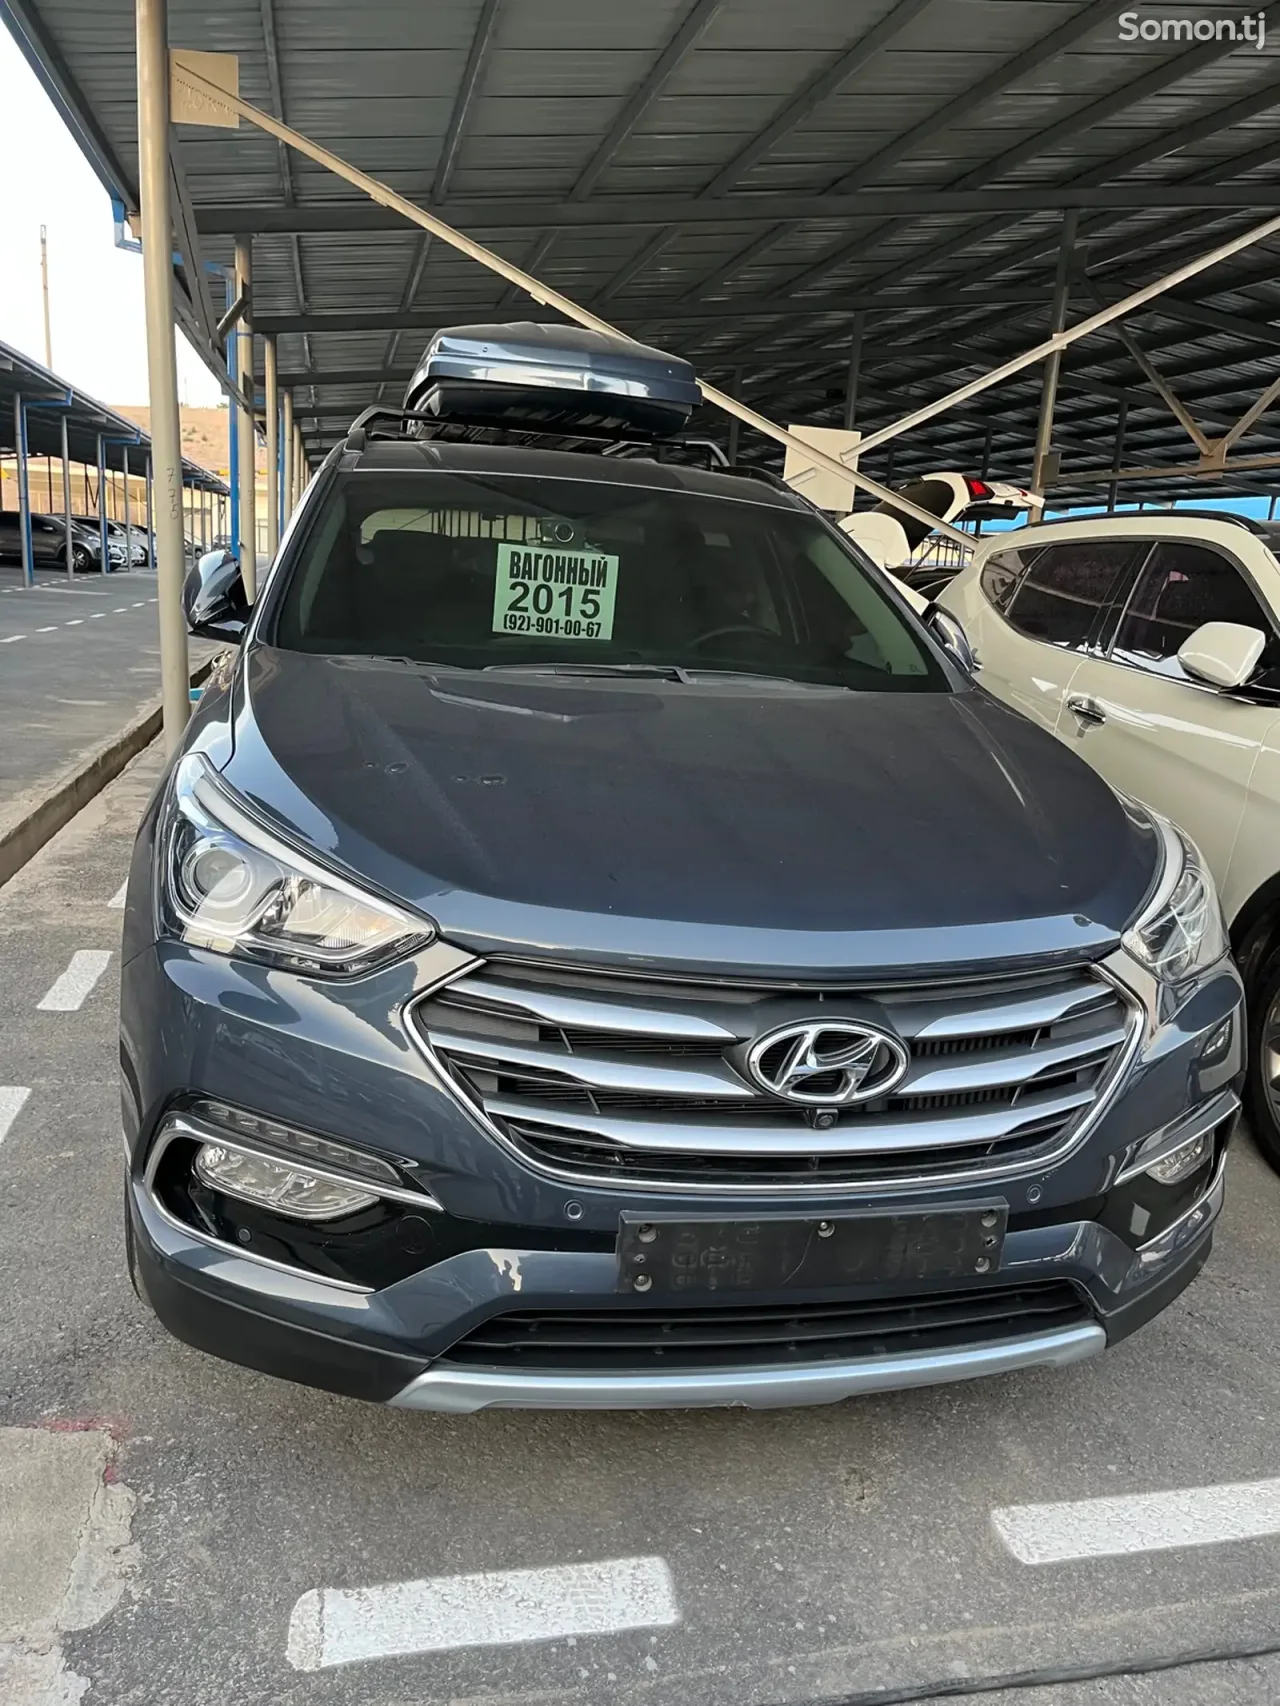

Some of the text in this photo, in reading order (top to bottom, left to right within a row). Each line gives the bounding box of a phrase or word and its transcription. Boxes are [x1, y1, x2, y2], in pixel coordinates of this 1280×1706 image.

[509, 551, 608, 588] ВАГОННЫЙ
[507, 581, 601, 619] 2015
[503, 614, 602, 638] (92)-901-00-67
